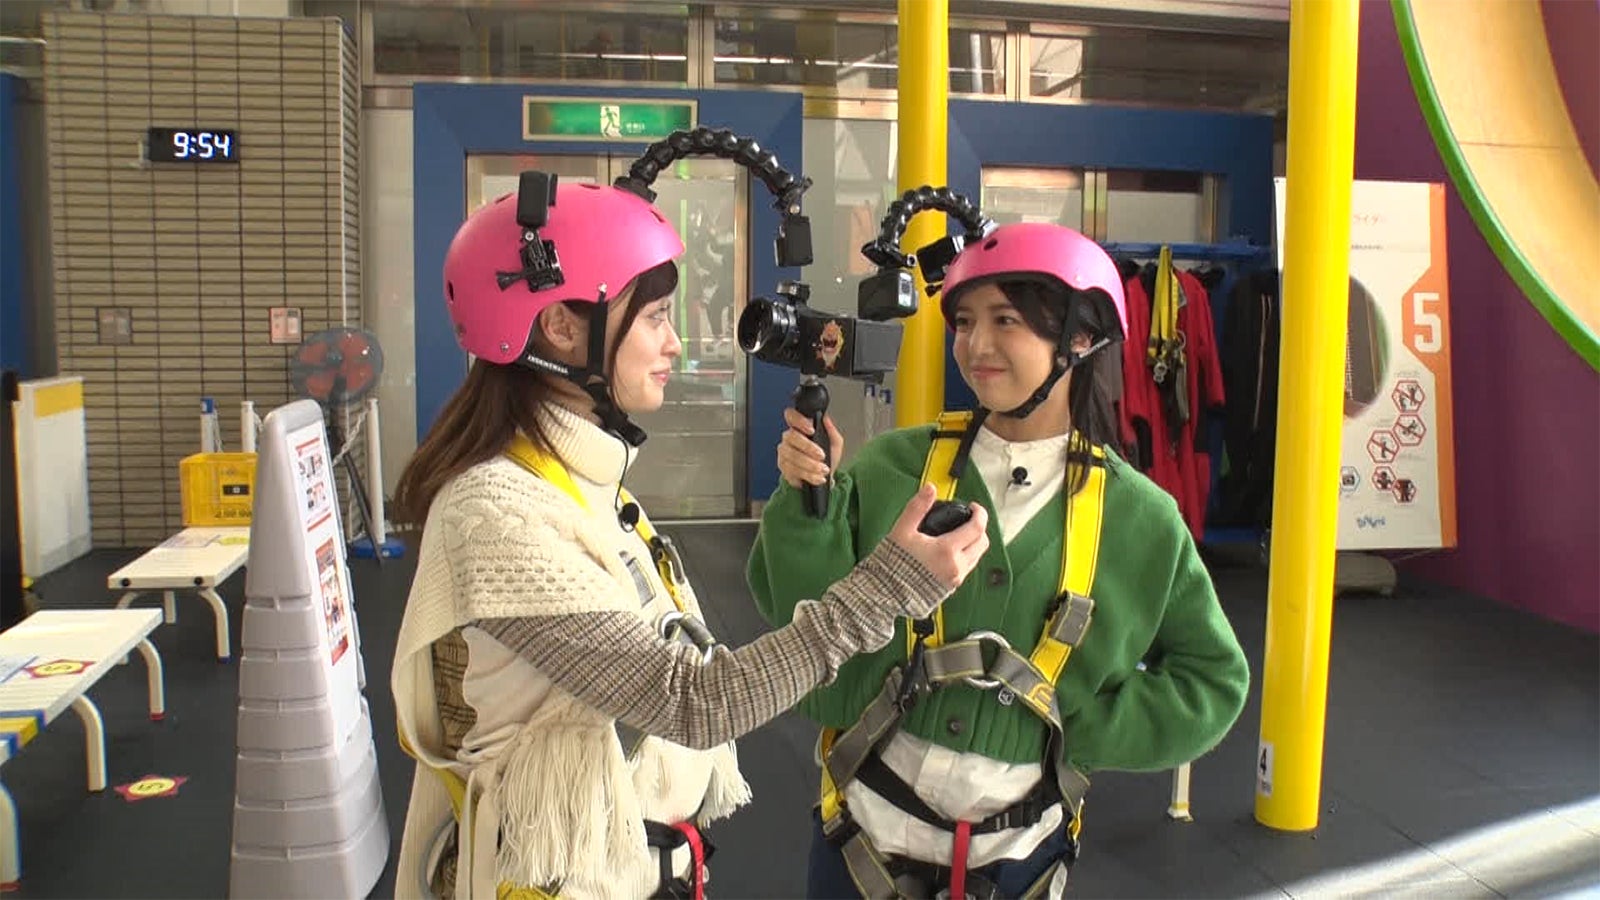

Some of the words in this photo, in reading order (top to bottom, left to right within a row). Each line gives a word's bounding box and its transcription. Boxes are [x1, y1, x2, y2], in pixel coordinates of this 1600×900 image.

[173, 132, 230, 158] 9:54
[1412, 292, 1442, 353] 5
[1259, 747, 1268, 776] 4
